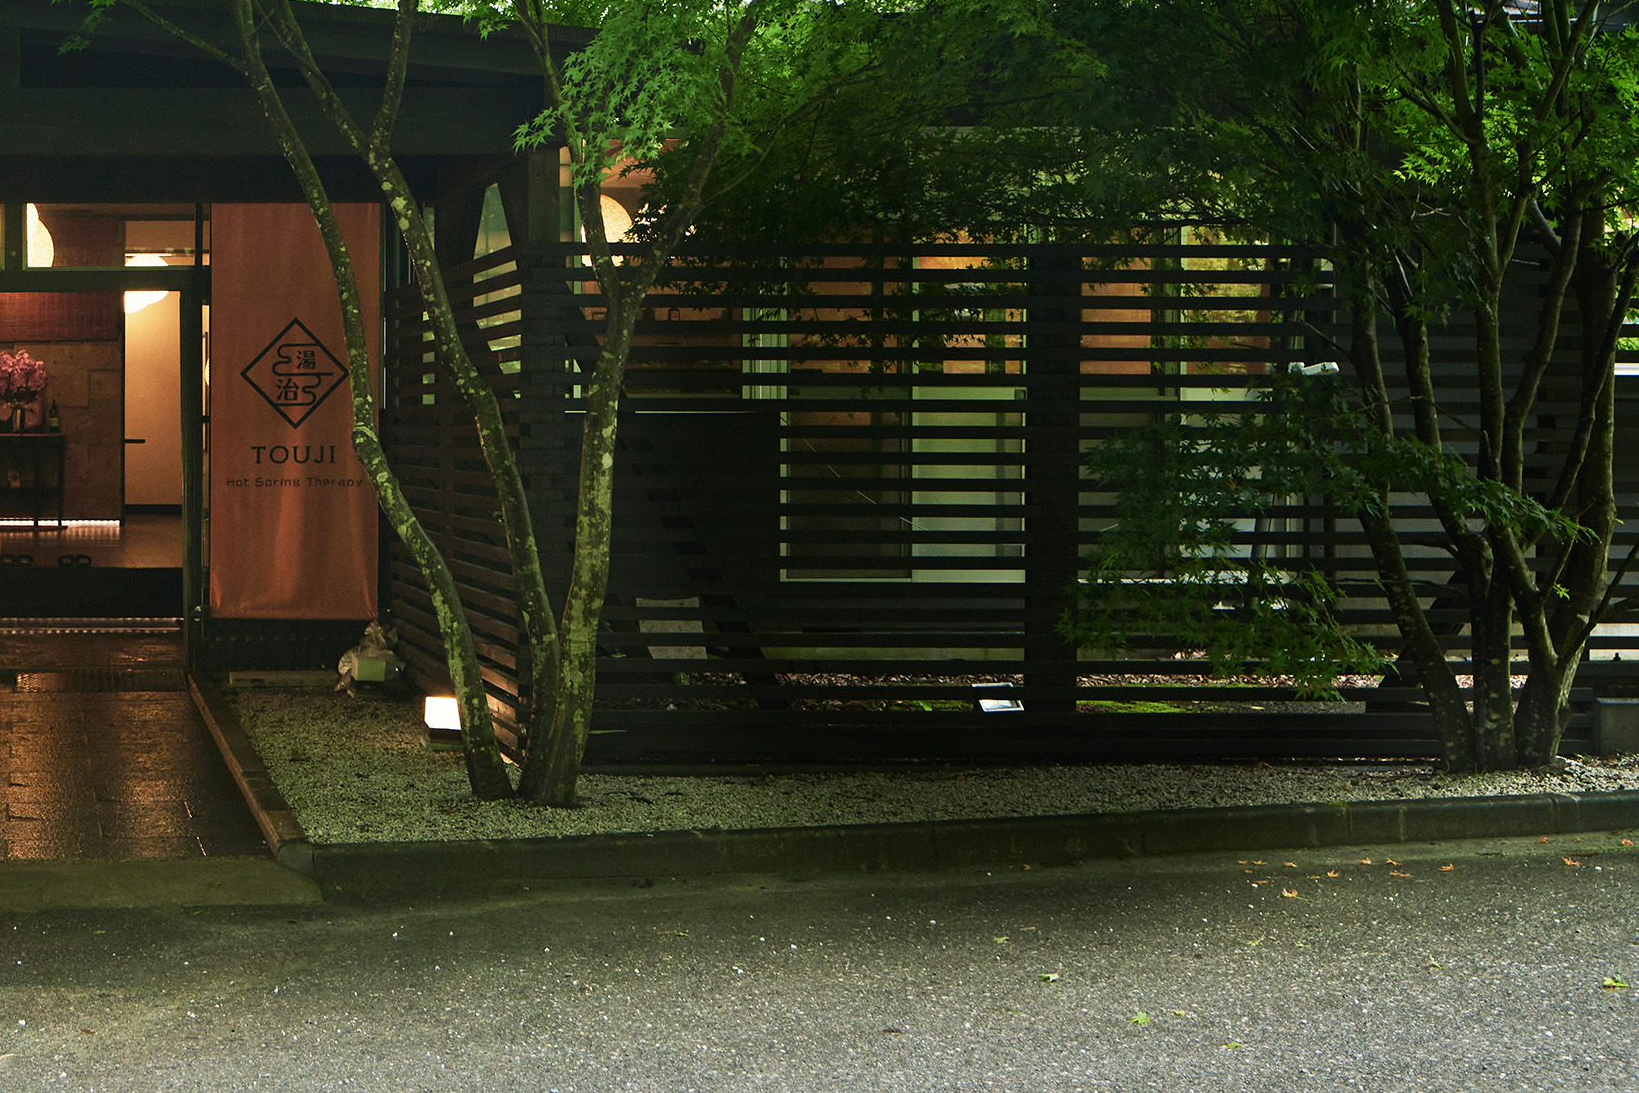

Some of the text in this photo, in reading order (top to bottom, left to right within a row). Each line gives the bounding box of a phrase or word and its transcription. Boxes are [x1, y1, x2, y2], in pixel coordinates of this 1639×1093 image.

[251, 445, 335, 464] TOUJI
[227, 477, 362, 488] Hot Spring Therapy
